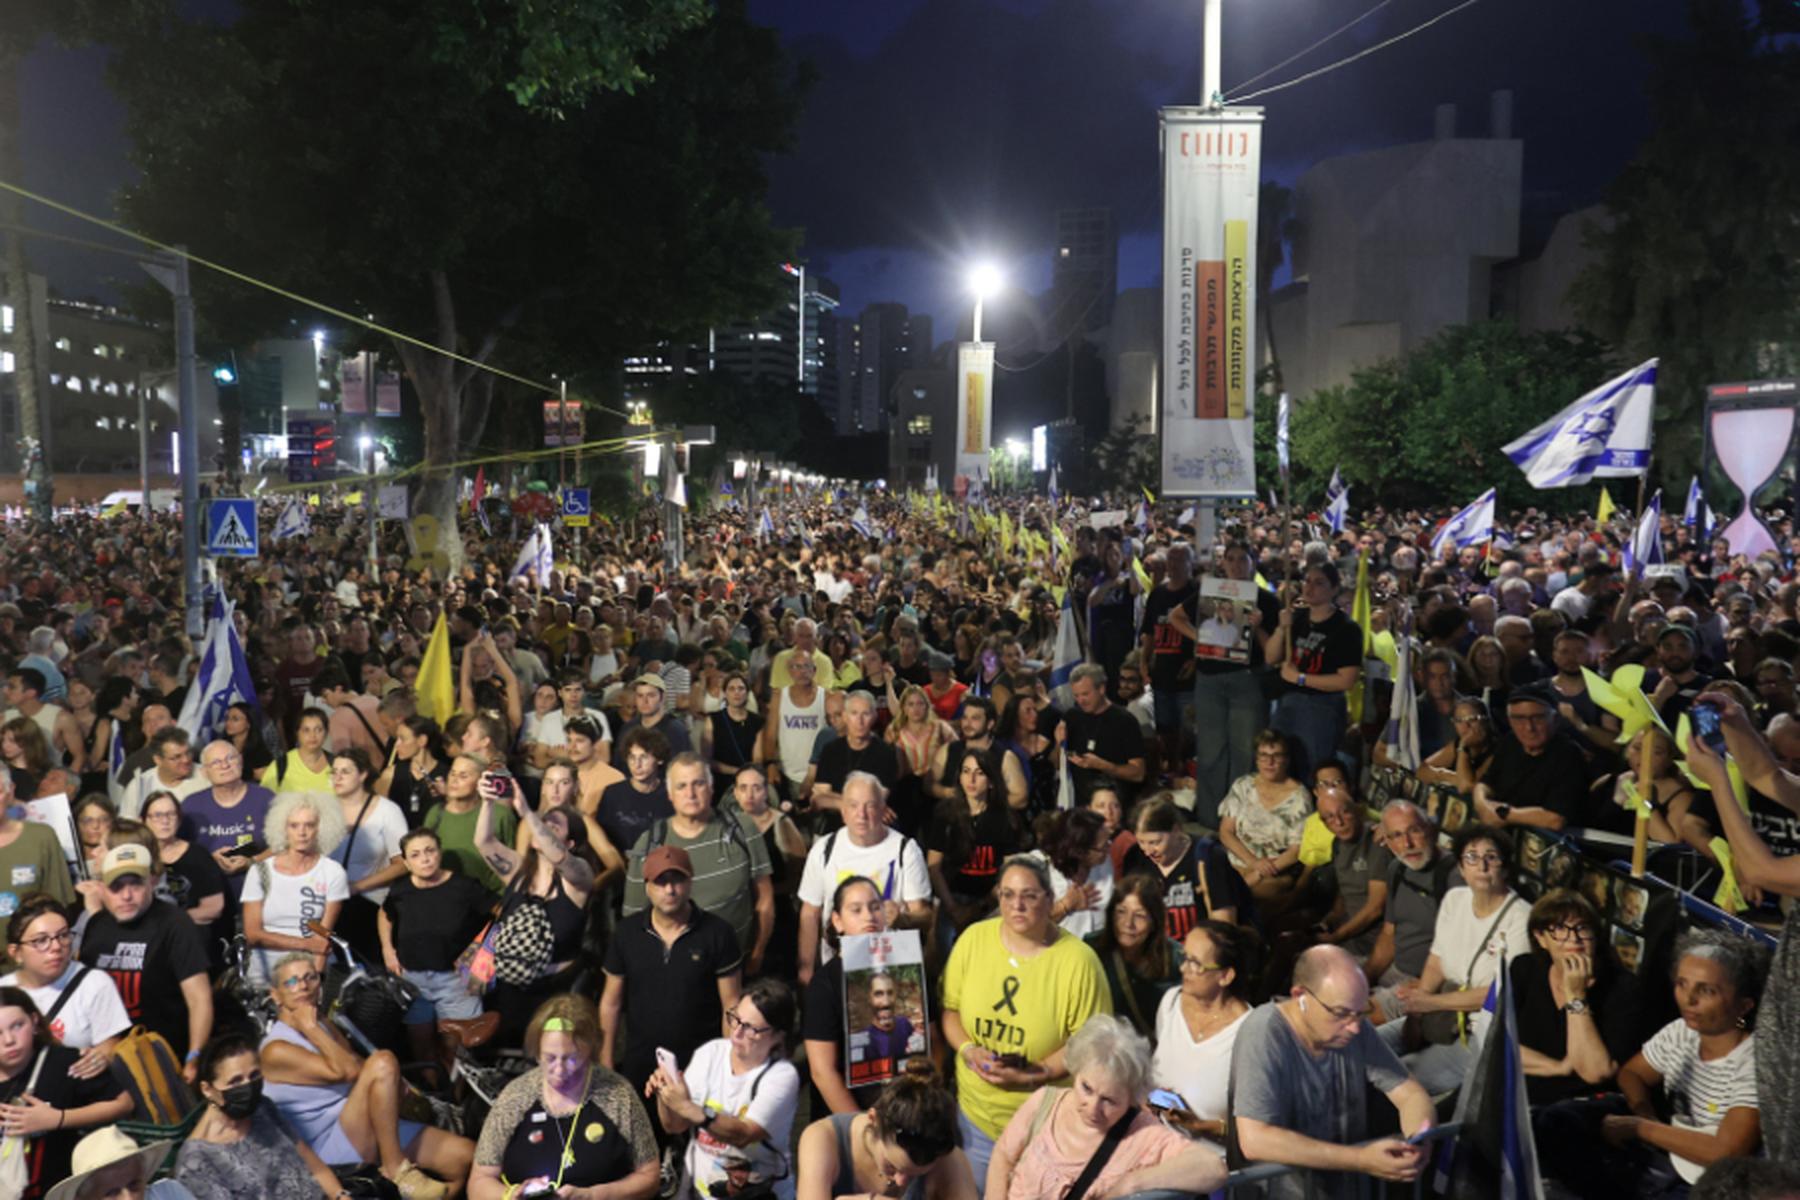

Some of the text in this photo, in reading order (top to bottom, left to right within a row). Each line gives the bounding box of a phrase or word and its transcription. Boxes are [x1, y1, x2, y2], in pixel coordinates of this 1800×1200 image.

[1177, 247, 1192, 391] סדנות כתיבה לכל גיל
[1206, 278, 1217, 389] מפגשי תרבות
[1231, 257, 1243, 390] הרצאות מקוונות
[783, 714, 819, 730] VANS
[208, 823, 245, 837] Music
[975, 1016, 1026, 1047] כולנו
